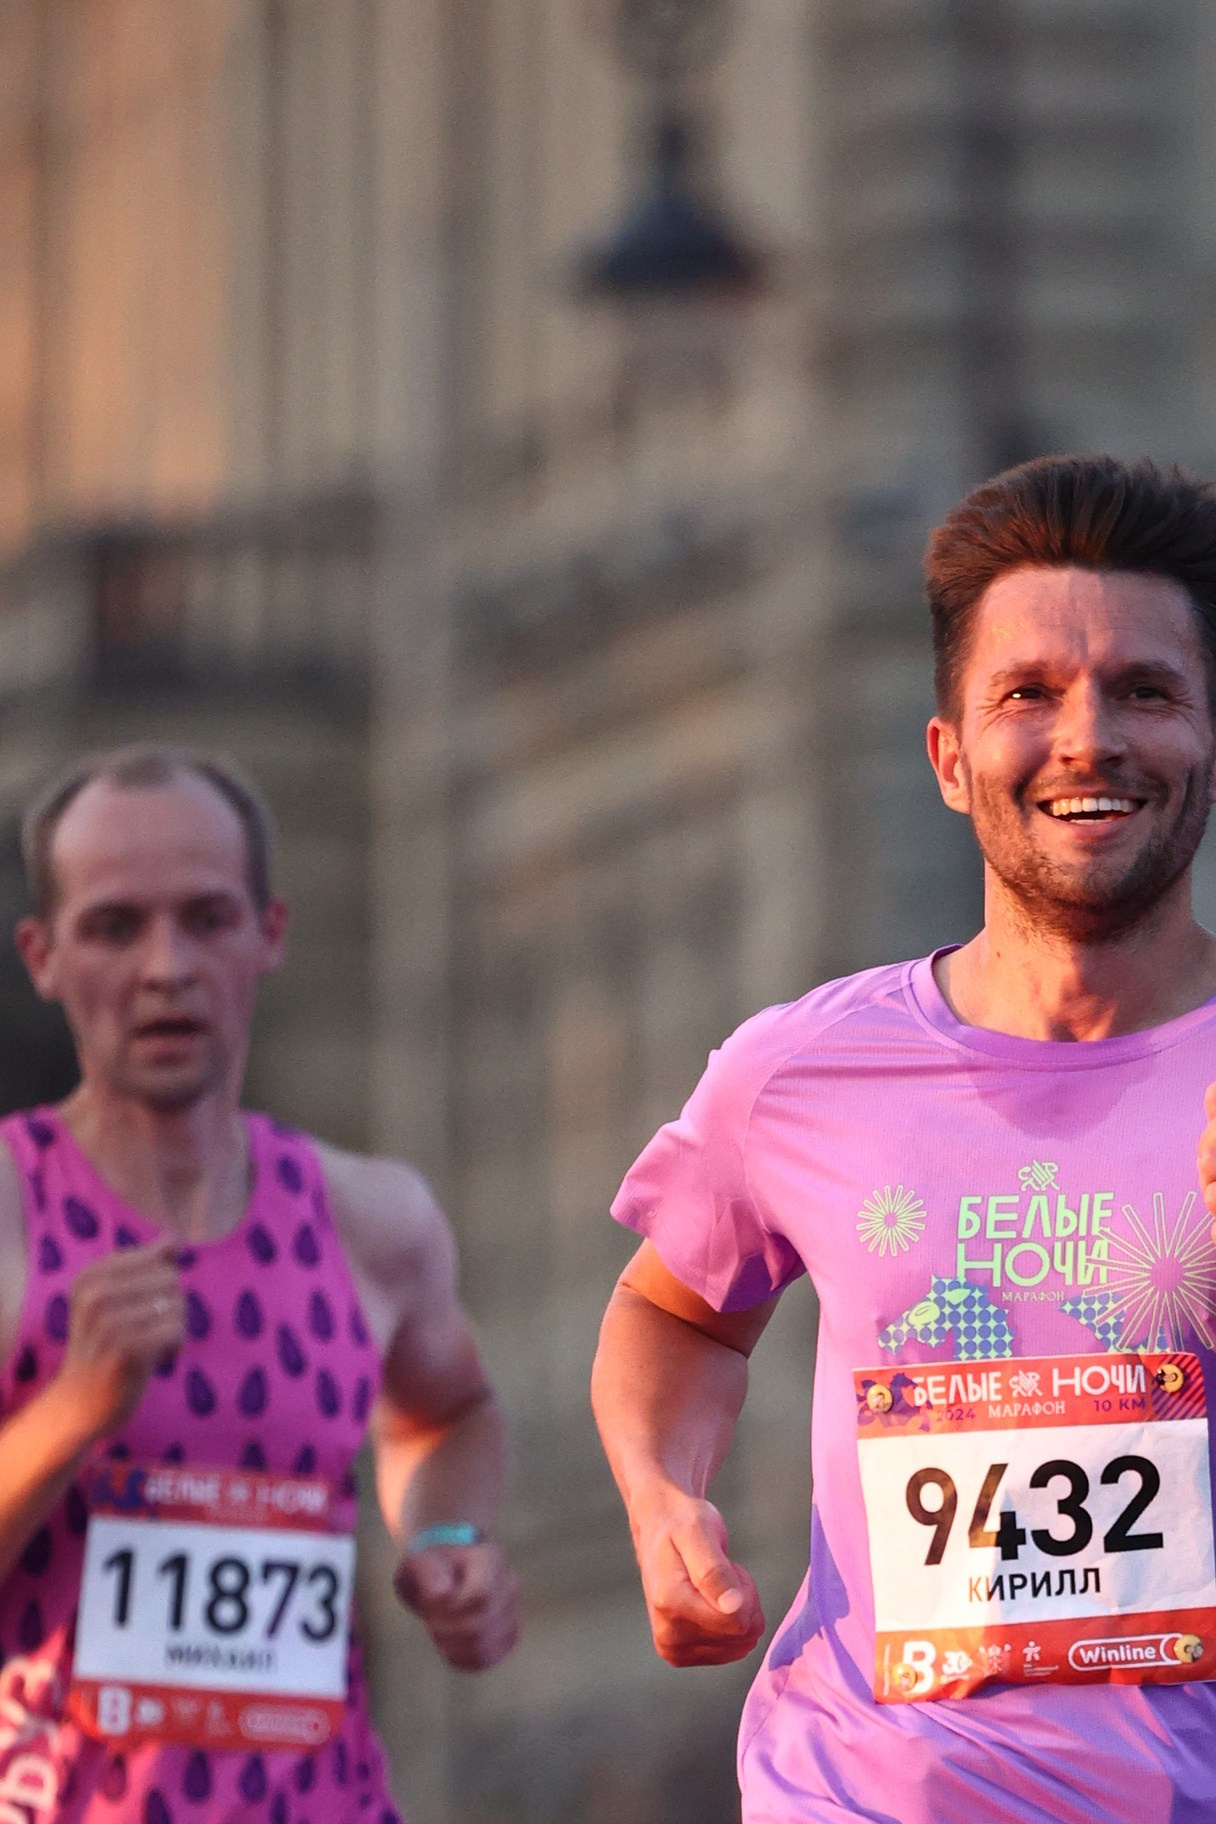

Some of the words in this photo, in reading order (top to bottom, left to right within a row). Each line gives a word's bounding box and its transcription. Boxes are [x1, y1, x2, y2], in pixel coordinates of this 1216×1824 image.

[956, 1191, 1115, 1240] БЕЛЫЕ
[956, 1239, 1110, 1288] НОЧИ
[1001, 1290, 1066, 1303] МАРАФОН
[911, 1371, 1003, 1406] БЕЛЫЕ
[1051, 1363, 1147, 1398] НОЧИ
[935, 1407, 977, 1422] 2024
[987, 1400, 1067, 1420] МАРАФОН
[1093, 1399, 1113, 1413] 10
[905, 1454, 1164, 1566] 9432
[104, 1548, 338, 1642] 11873
[967, 1566, 1102, 1603] КИРИЛЛ
[1078, 1642, 1157, 1665] Winline
